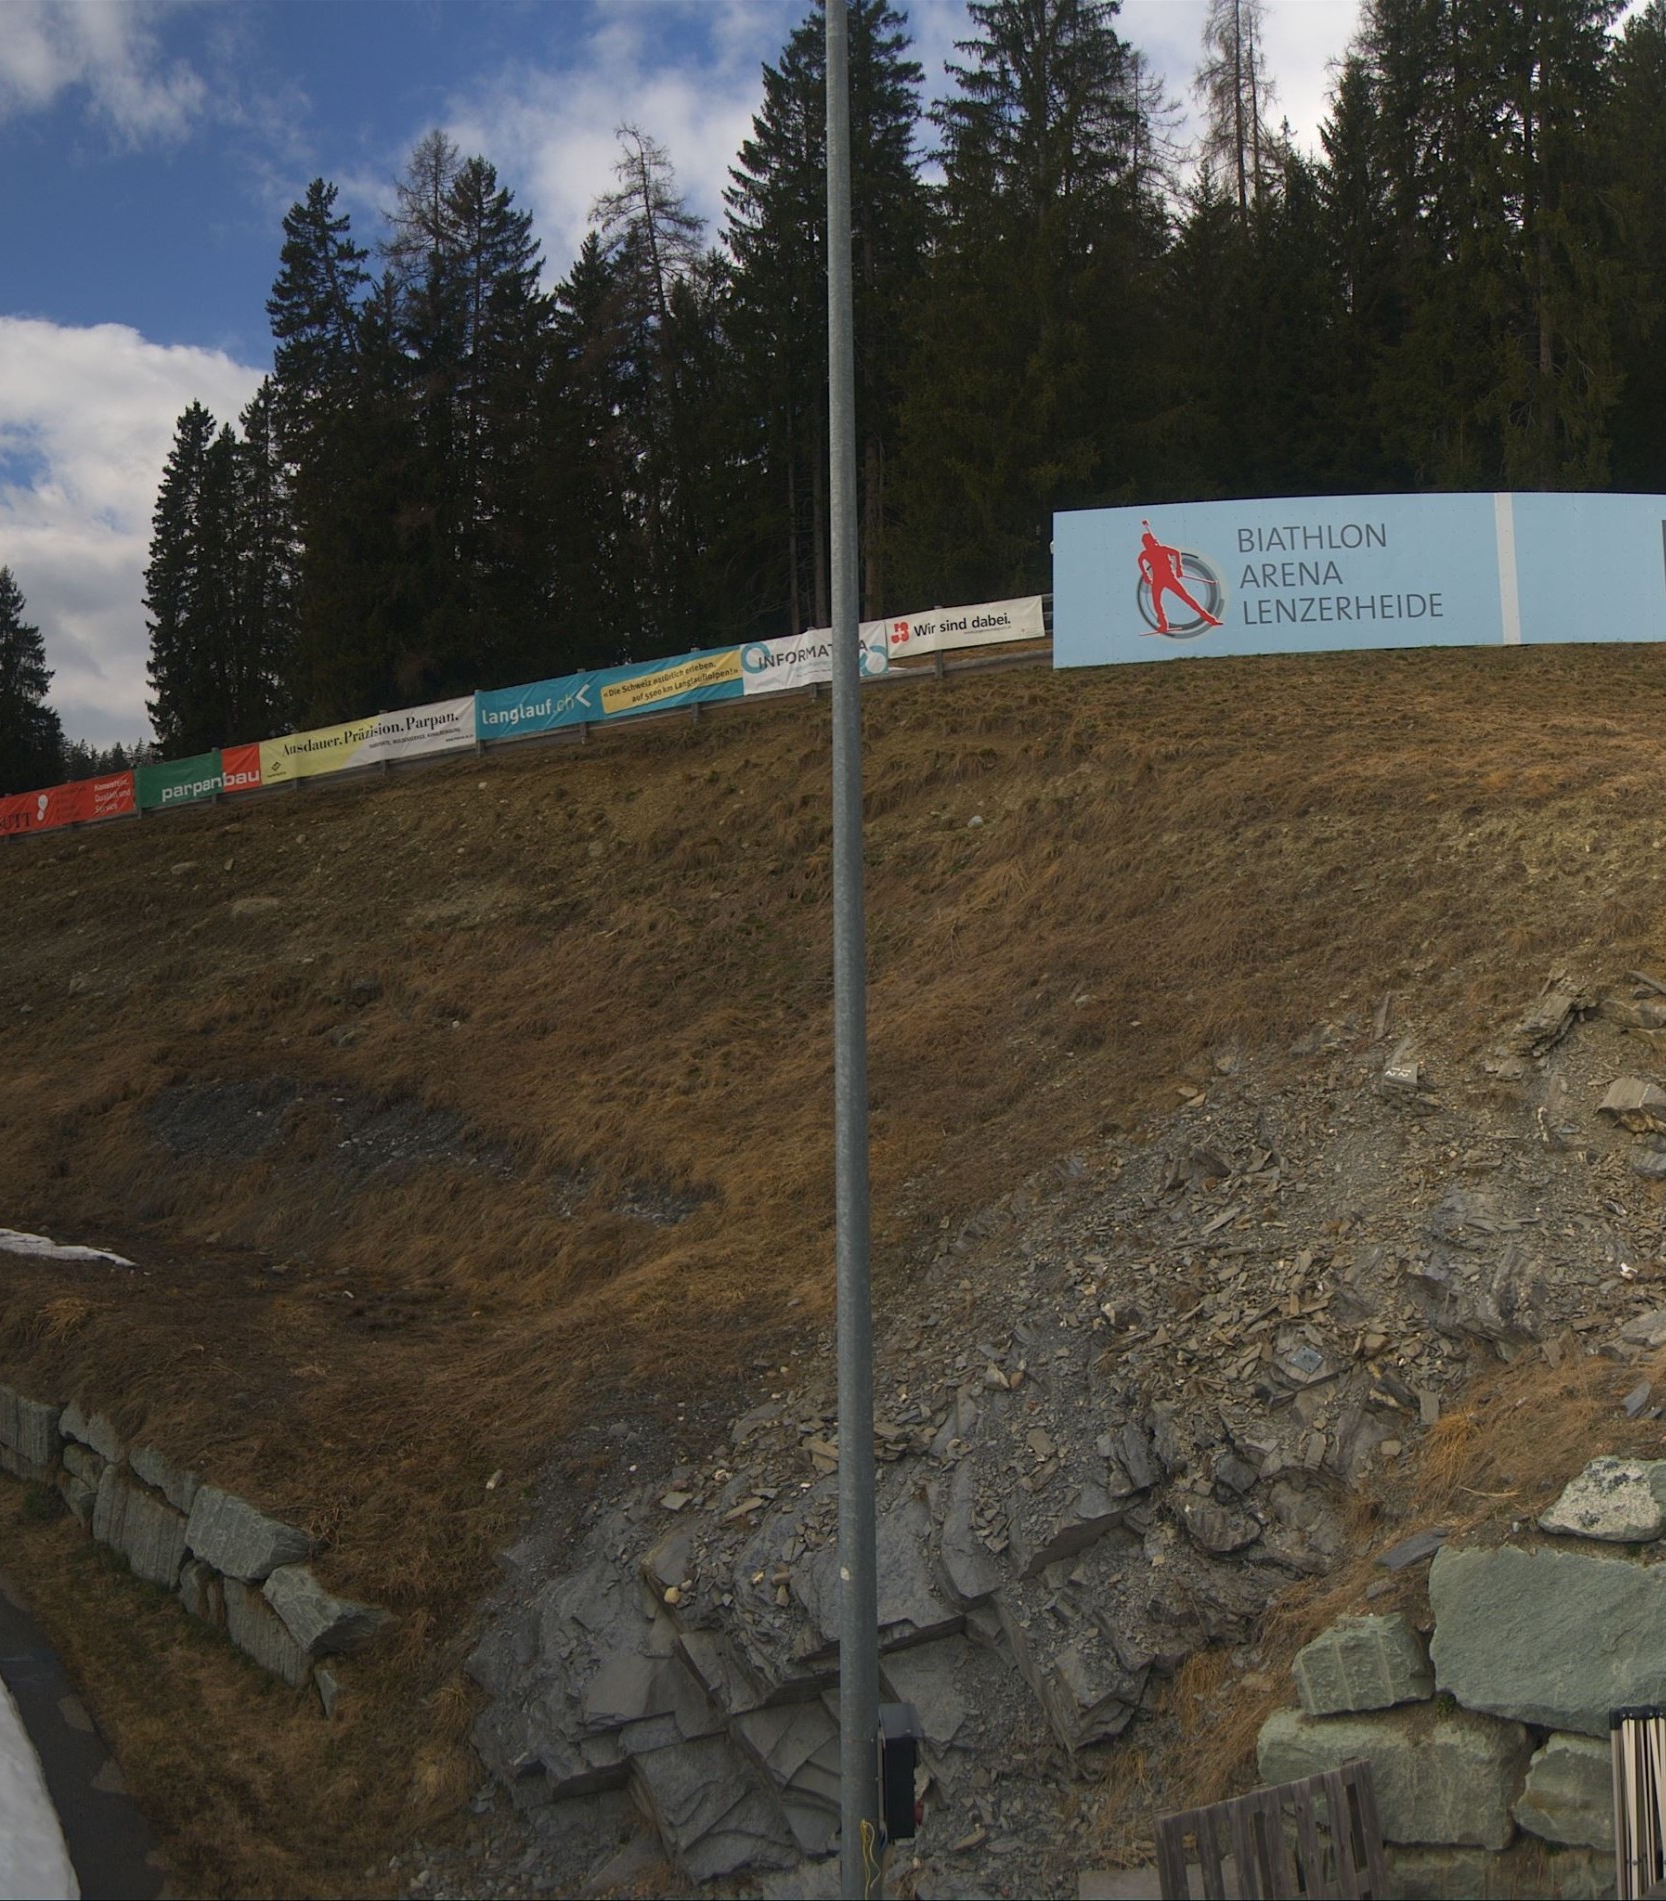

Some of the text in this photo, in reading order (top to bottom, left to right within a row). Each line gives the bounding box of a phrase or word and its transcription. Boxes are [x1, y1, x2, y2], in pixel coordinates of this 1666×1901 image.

[1237, 523, 1387, 552] BIATHLON
[1239, 561, 1343, 588] ARENA
[1243, 593, 1443, 624] LENZERHEIDE
[914, 622, 936, 637] Wir
[939, 617, 967, 633] sind
[971, 612, 1011, 629] dabei.
[758, 639, 867, 670] INFORMAA
[621, 678, 652, 694] Schweiz
[633, 692, 644, 703] auf
[645, 688, 662, 701] 5500
[662, 685, 673, 696] km
[283, 736, 342, 756] Ausdauer.
[344, 722, 404, 744] Präzision.
[405, 712, 459, 731] Parpan.
[162, 770, 260, 802] parpanbau
